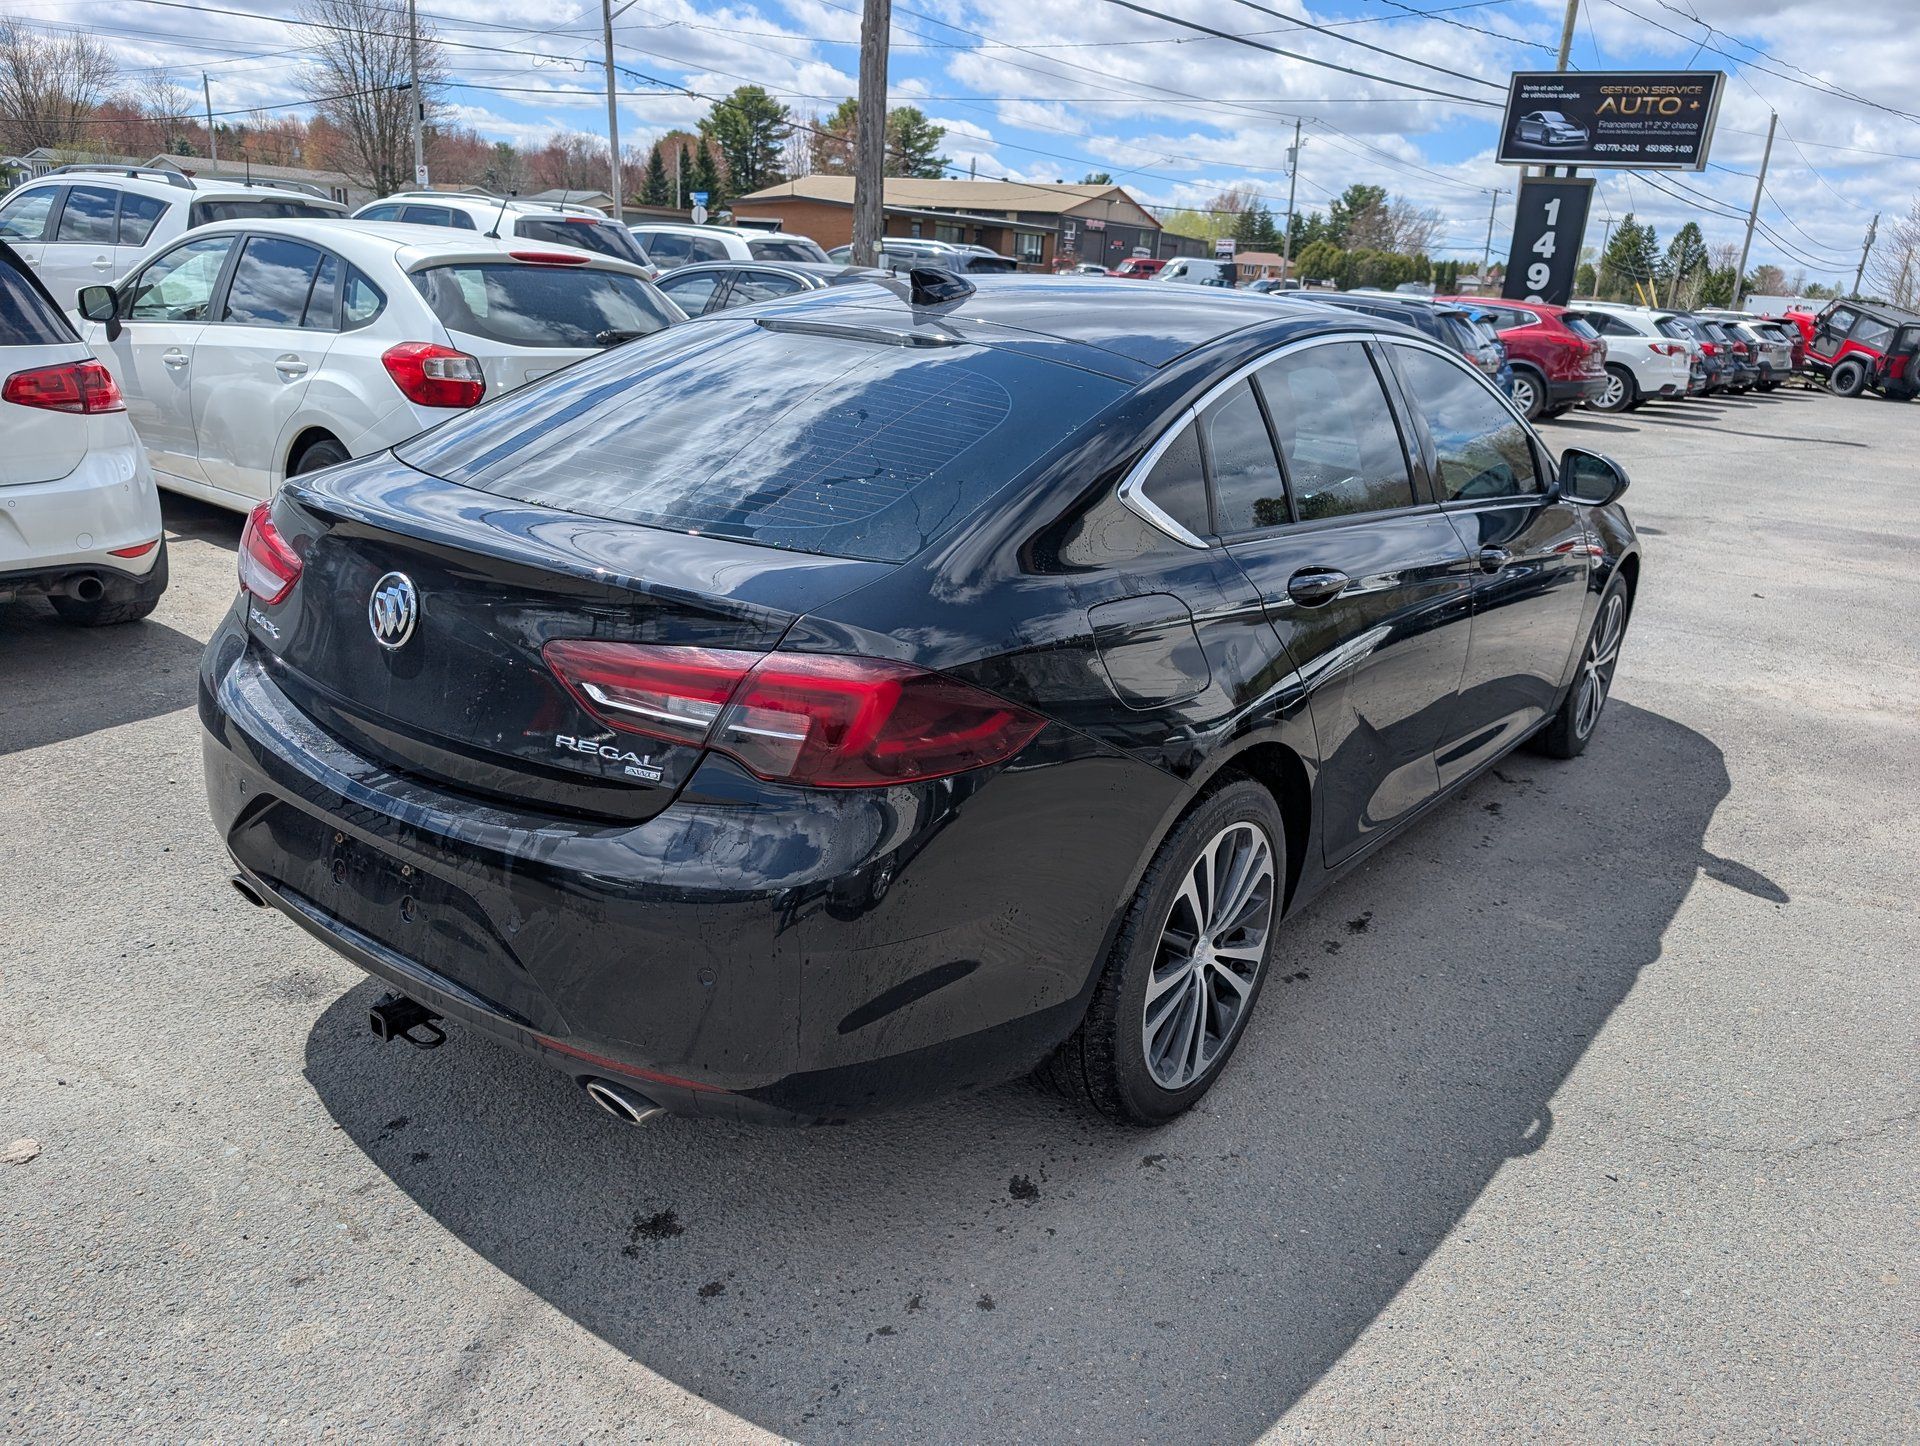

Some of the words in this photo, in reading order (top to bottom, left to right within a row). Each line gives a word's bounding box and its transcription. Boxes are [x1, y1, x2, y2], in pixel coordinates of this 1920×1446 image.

[1599, 86, 1648, 94] GESTION
[1650, 86, 1703, 94] SERVICE
[1594, 96, 1682, 116] AUTO
[1598, 120, 1642, 129] Financement
[1671, 121, 1698, 130] chance
[556, 734, 665, 771] REGAL
[625, 766, 661, 781] AWD
